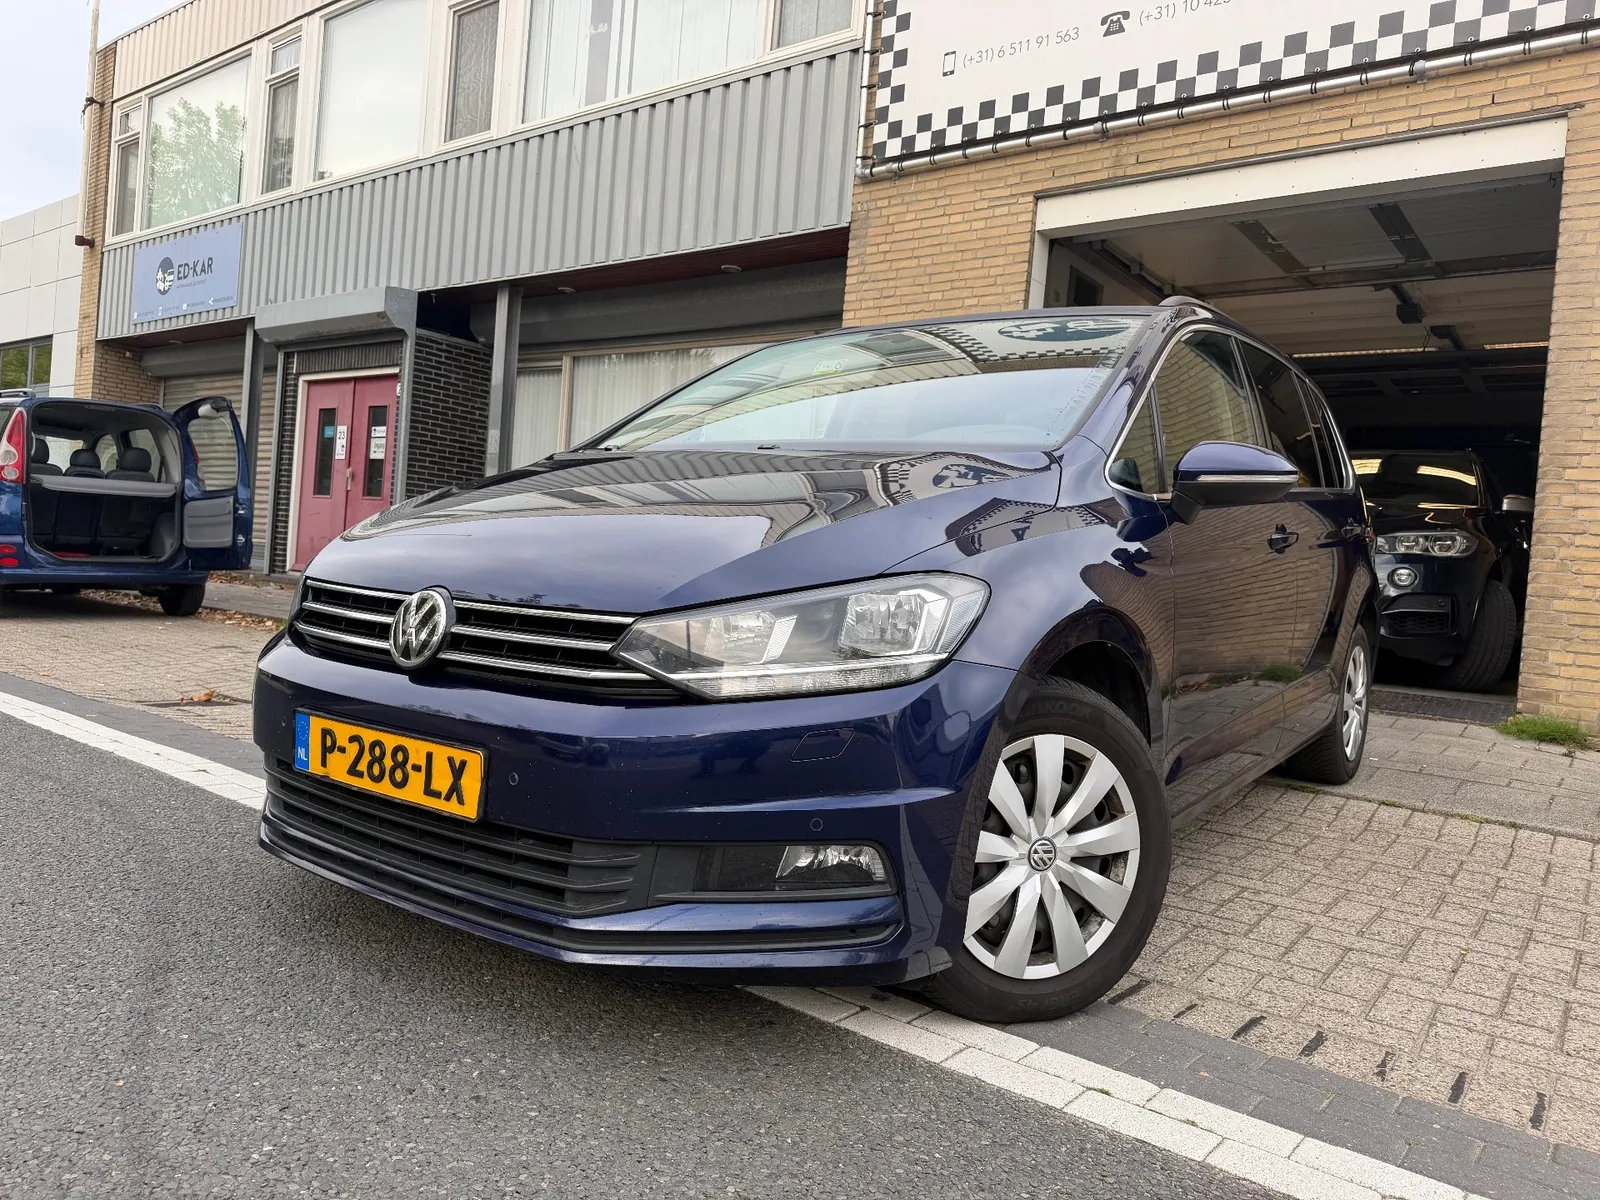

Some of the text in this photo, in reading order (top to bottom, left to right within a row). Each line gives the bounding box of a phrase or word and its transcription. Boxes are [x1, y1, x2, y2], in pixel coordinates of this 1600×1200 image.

[1139, 2, 1176, 26] (+31)
[1182, 0, 1200, 13] 10
[1009, 38, 1031, 56] 511
[1036, 34, 1050, 48] 91
[1055, 26, 1080, 45] 563
[298, 747, 308, 761] NL
[320, 727, 468, 806] P-288-LX
